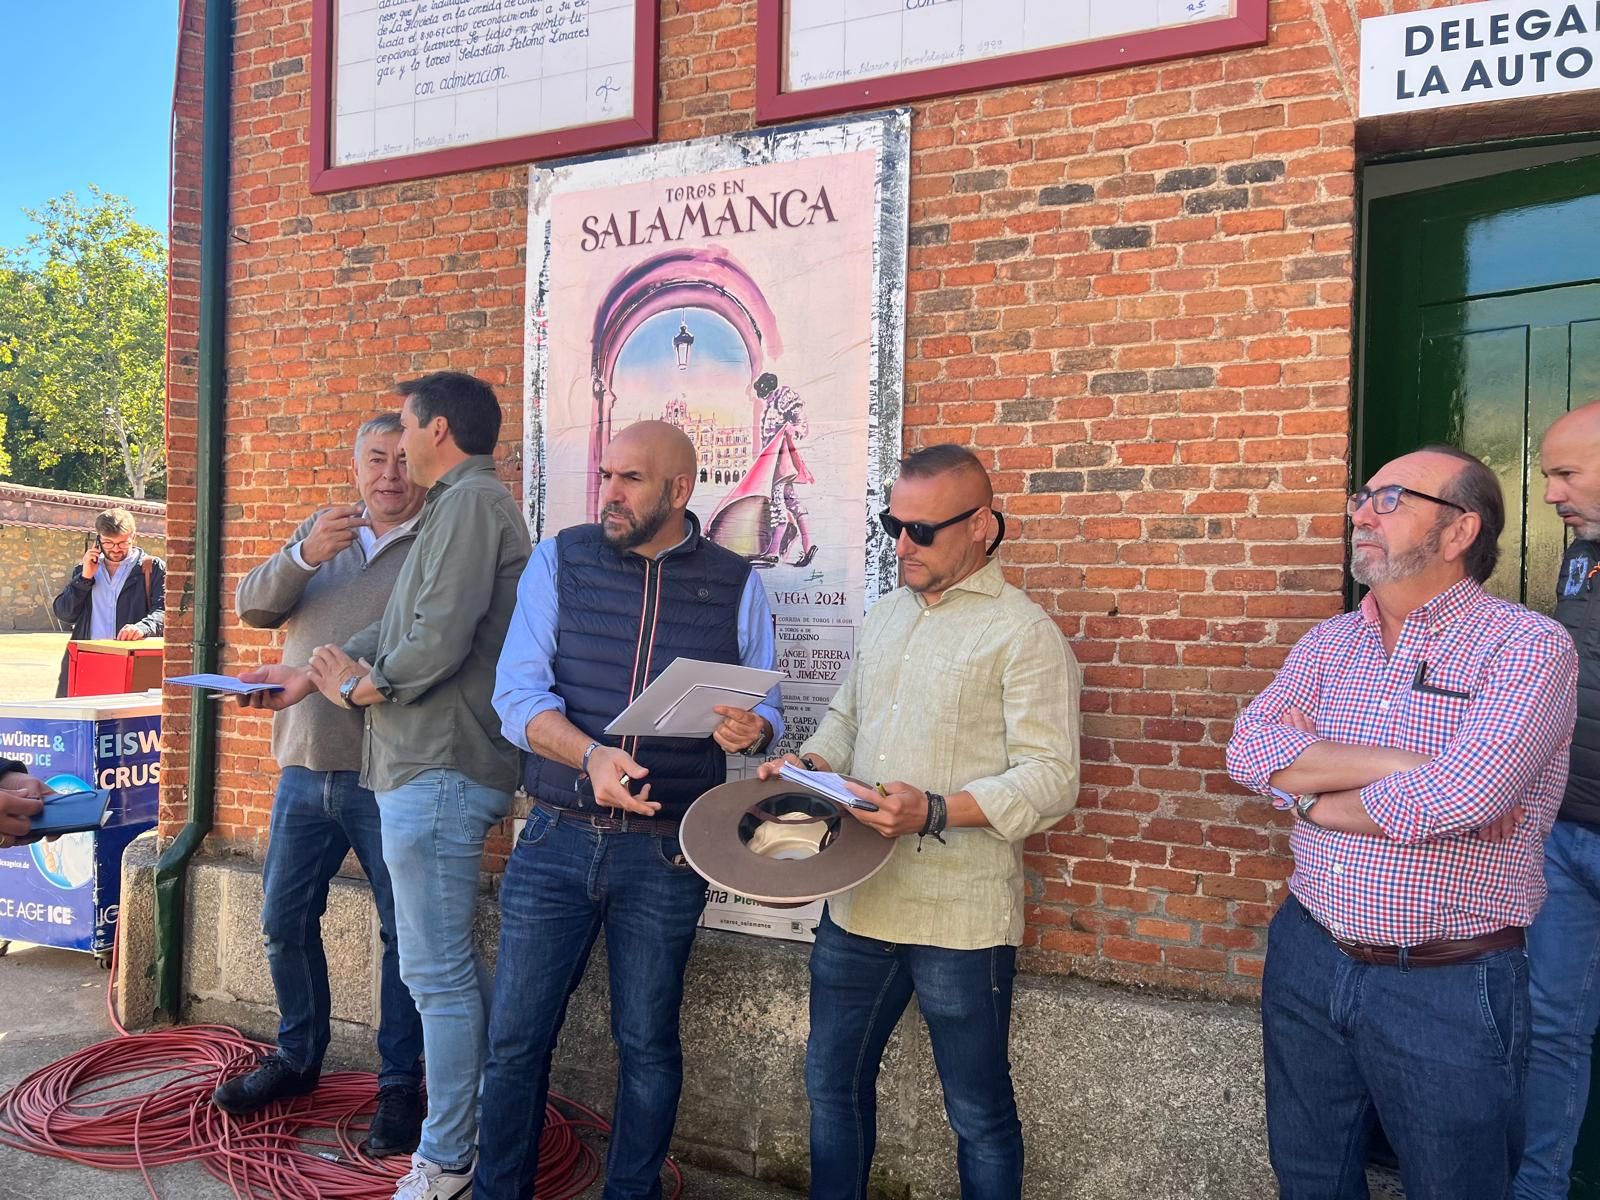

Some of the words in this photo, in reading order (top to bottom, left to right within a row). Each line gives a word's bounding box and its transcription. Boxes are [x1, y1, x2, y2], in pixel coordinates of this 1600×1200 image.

[545, 5, 553, 13] a
[559, 1, 571, 11] su
[377, 25, 388, 36] de
[389, 19, 402, 34] La
[443, 12, 452, 20] en
[455, 7, 466, 19] la
[1405, 0, 1600, 57] DELEGA
[399, 65, 405, 80] y
[411, 58, 420, 71] lo
[507, 35, 545, 51] Palomo
[549, 27, 589, 43] Linares
[1397, 65, 1450, 100] LA
[1461, 46, 1593, 92] AUTO
[415, 81, 434, 96] con
[665, 183, 716, 203] TOROS
[723, 179, 745, 195] EN
[580, 185, 839, 252] SALAMANCA
[774, 591, 809, 605] VEGA
[814, 591, 847, 606] 2024
[778, 632, 820, 641] VELLOSINO
[783, 648, 808, 658] ÁNGEL
[811, 649, 851, 660] PERERA
[794, 659, 806, 669] DE
[811, 660, 841, 670] JUSTO
[796, 669, 837, 681] JIMÉNEZ
[0, 731, 51, 748] WÜRFEL
[53, 735, 65, 752] &
[35, 754, 51, 766] ICE
[17, 901, 44, 921] AGE
[48, 905, 72, 925] ICE
